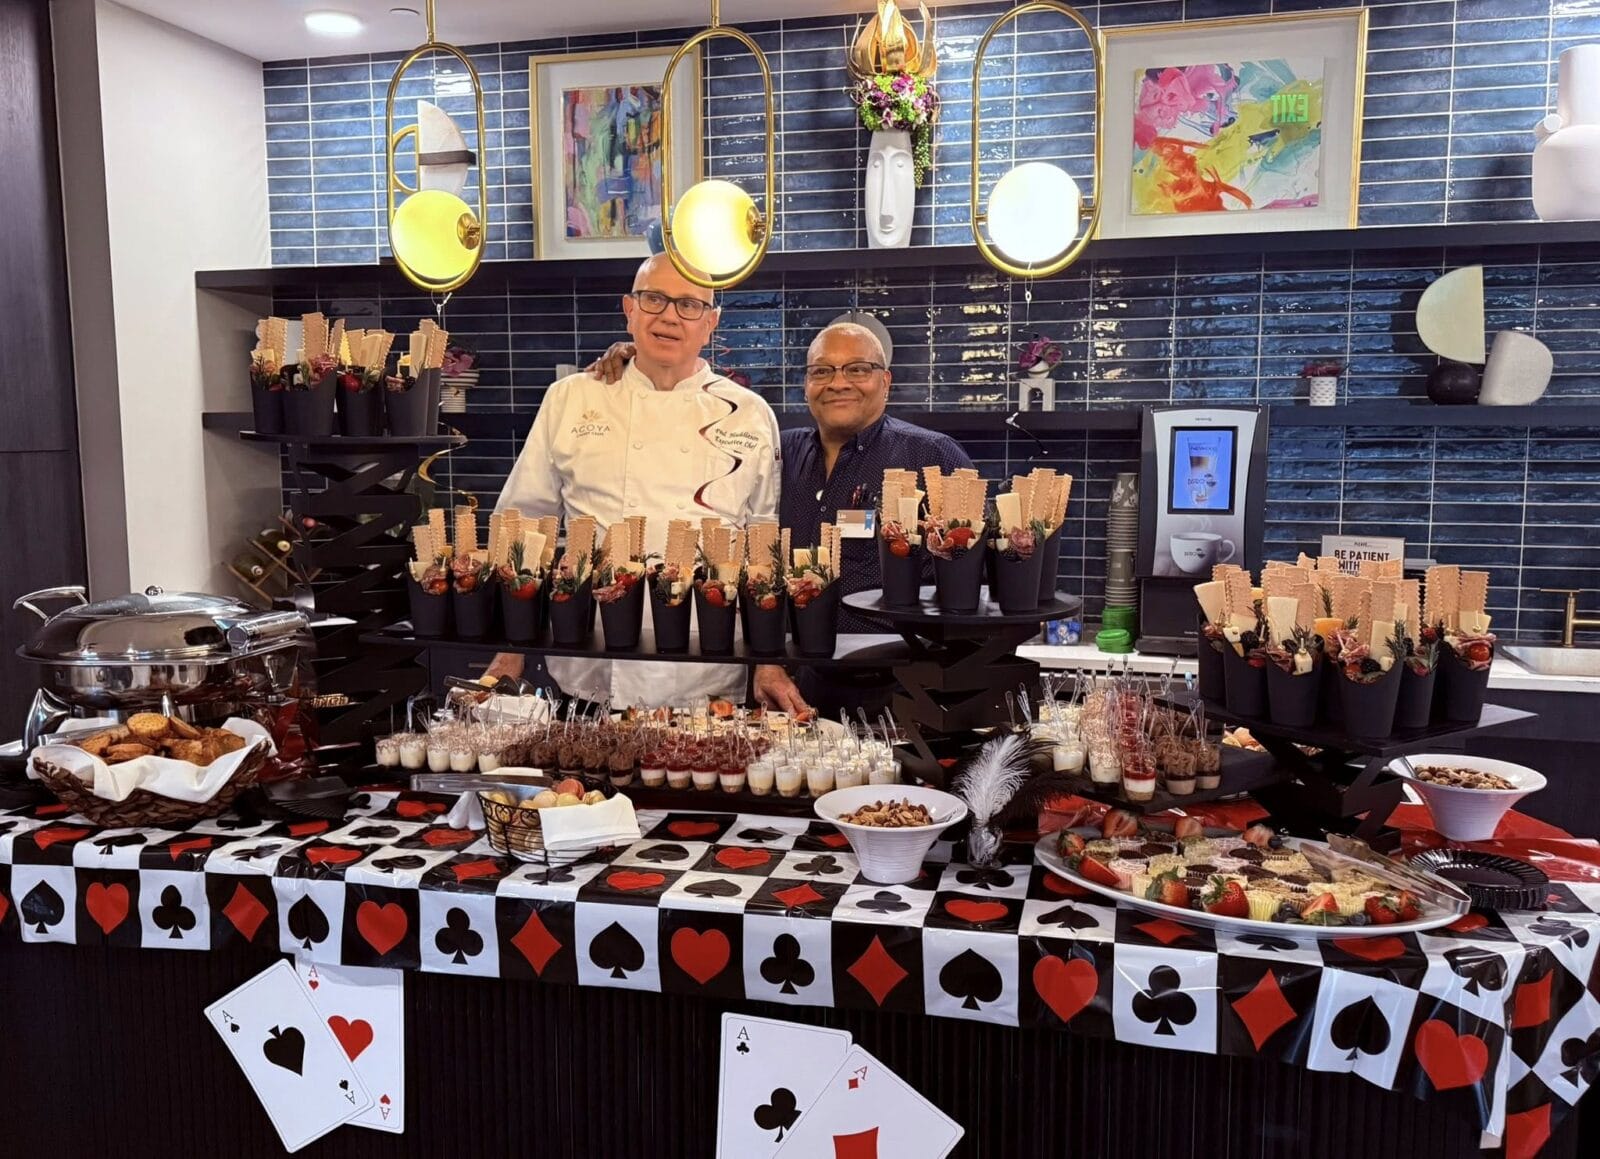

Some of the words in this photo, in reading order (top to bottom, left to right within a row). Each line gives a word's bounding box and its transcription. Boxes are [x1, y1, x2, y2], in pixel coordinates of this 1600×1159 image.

[571, 424, 610, 434] ACOYA
[1334, 549, 1347, 560] BE
[1349, 550, 1390, 562] PATIENT
[1338, 560, 1360, 571] WITH
[308, 964, 319, 978] A
[222, 1009, 234, 1023] A
[736, 1025, 750, 1041] A
[853, 1065, 869, 1081] A
[345, 1090, 356, 1105] A
[379, 1107, 391, 1121] A
